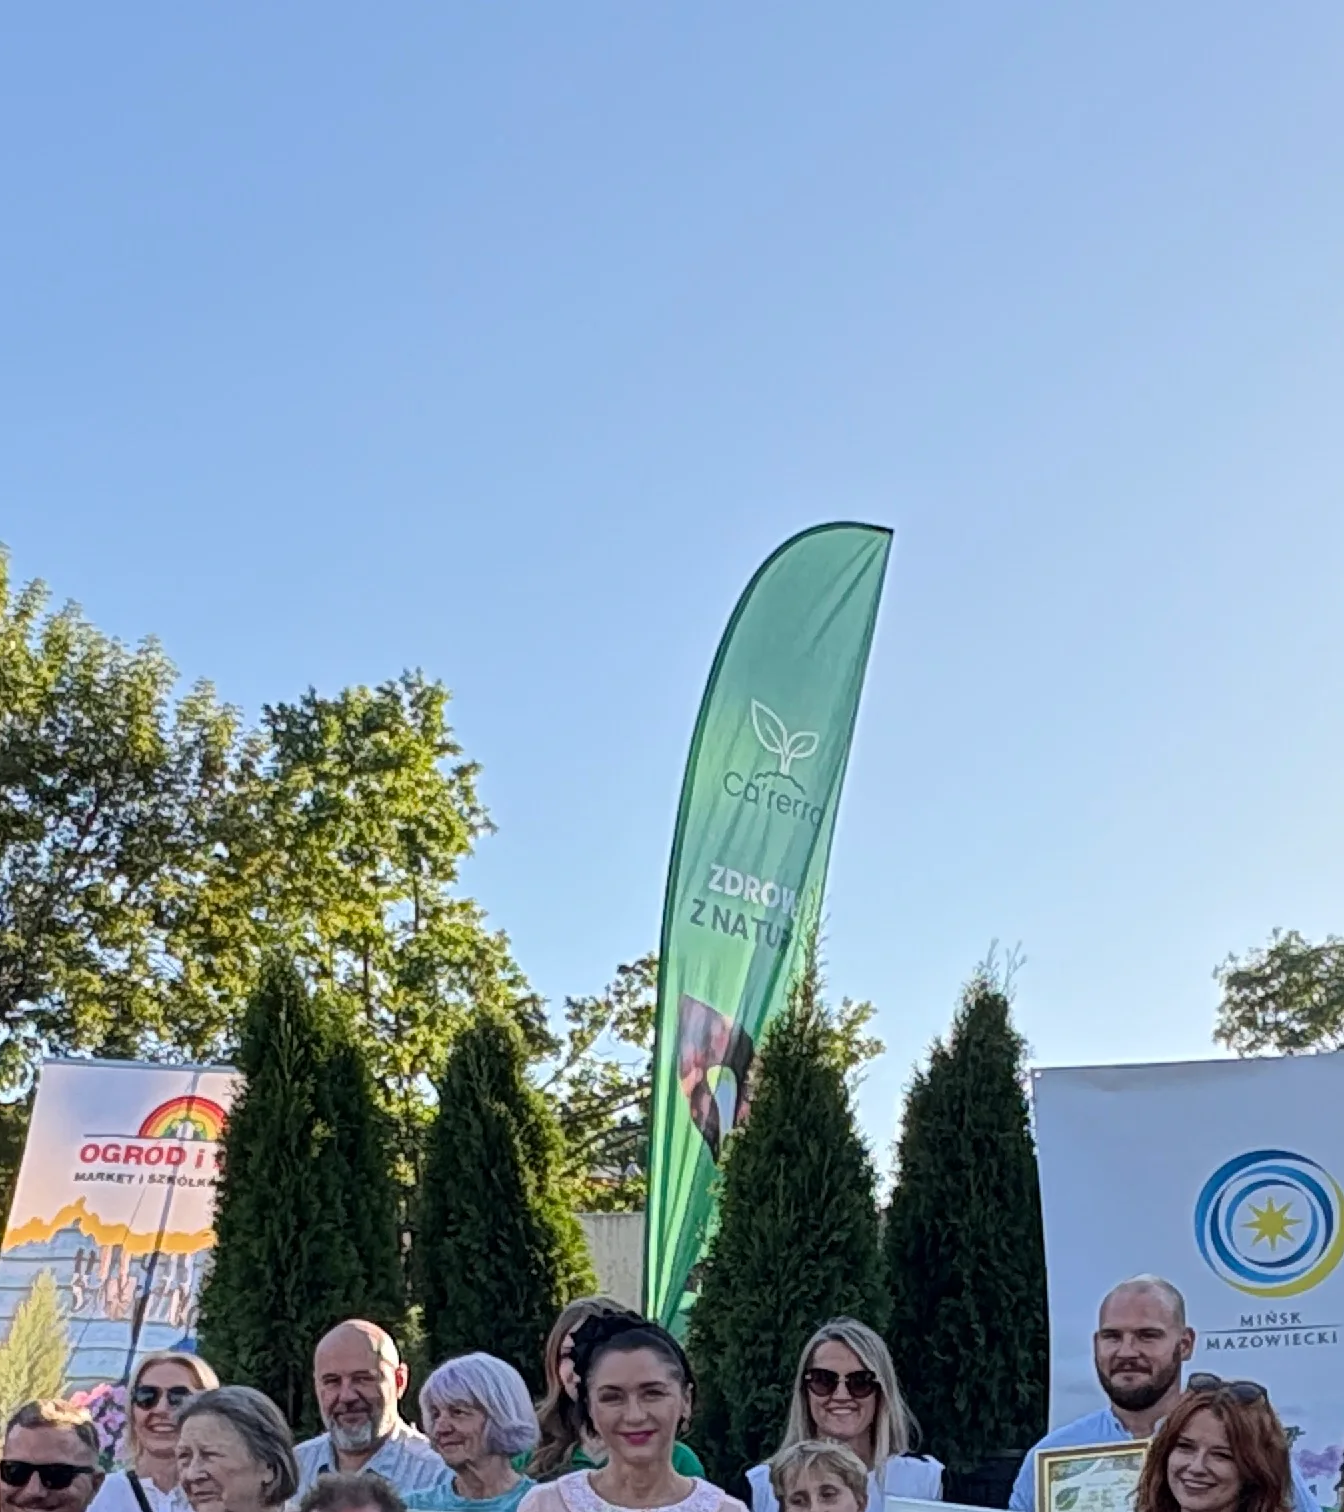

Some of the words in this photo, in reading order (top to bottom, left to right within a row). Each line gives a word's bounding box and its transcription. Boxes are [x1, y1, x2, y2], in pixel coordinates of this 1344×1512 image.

[708, 863, 798, 918] ZDROW
[690, 898, 706, 927] Z
[711, 904, 785, 949] NATU
[73, 1172, 136, 1185] MARKET
[1240, 1310, 1302, 1327] MIŃSK
[1204, 1330, 1339, 1351] MAZOWIECKI
